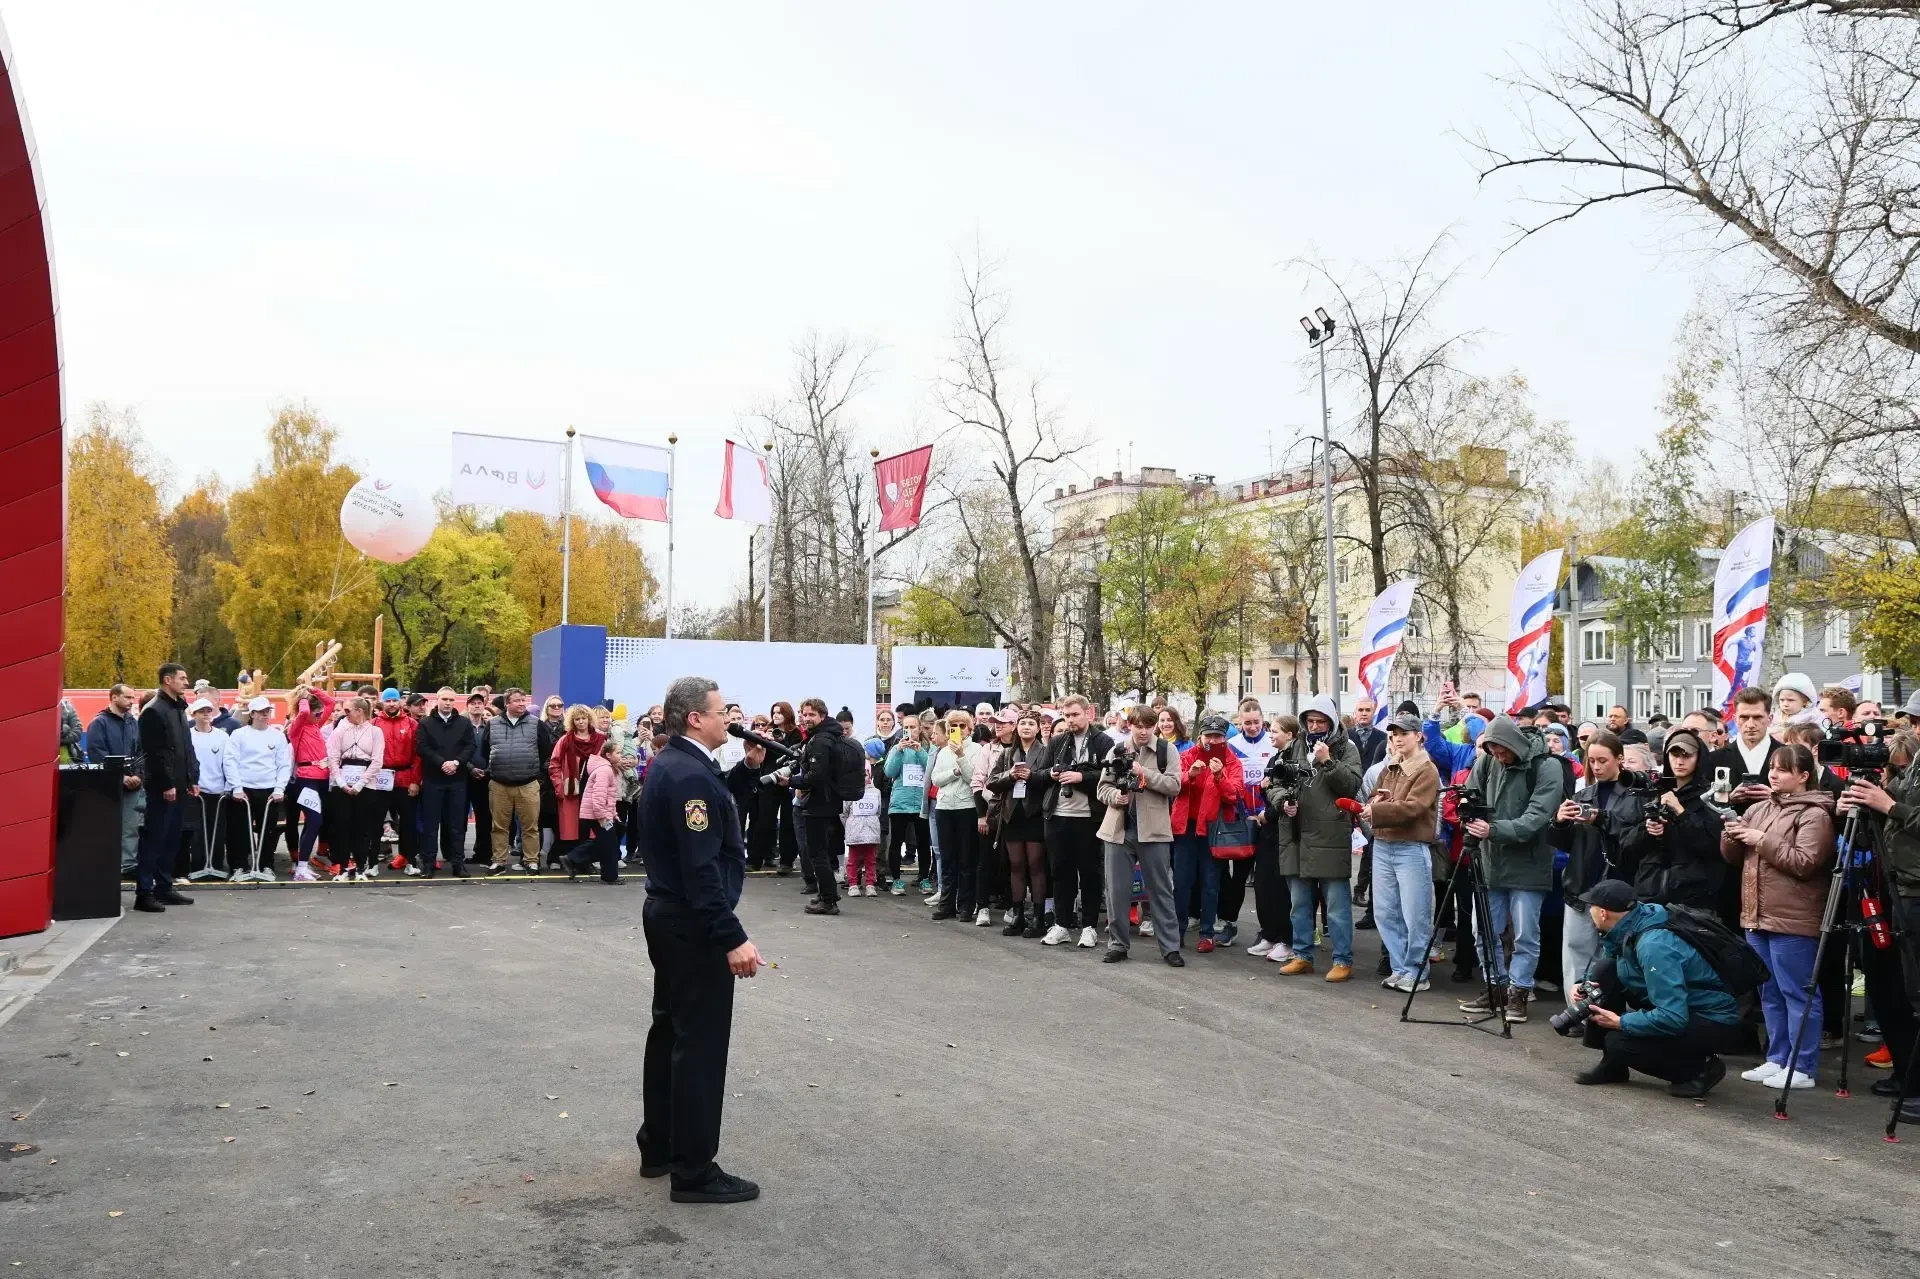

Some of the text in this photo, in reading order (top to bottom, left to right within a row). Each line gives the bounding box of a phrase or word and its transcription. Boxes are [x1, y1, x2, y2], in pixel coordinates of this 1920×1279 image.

[907, 773, 925, 782] 062
[1244, 769, 1263, 779] 169
[303, 798, 319, 809] 017
[858, 802, 875, 810] 039
